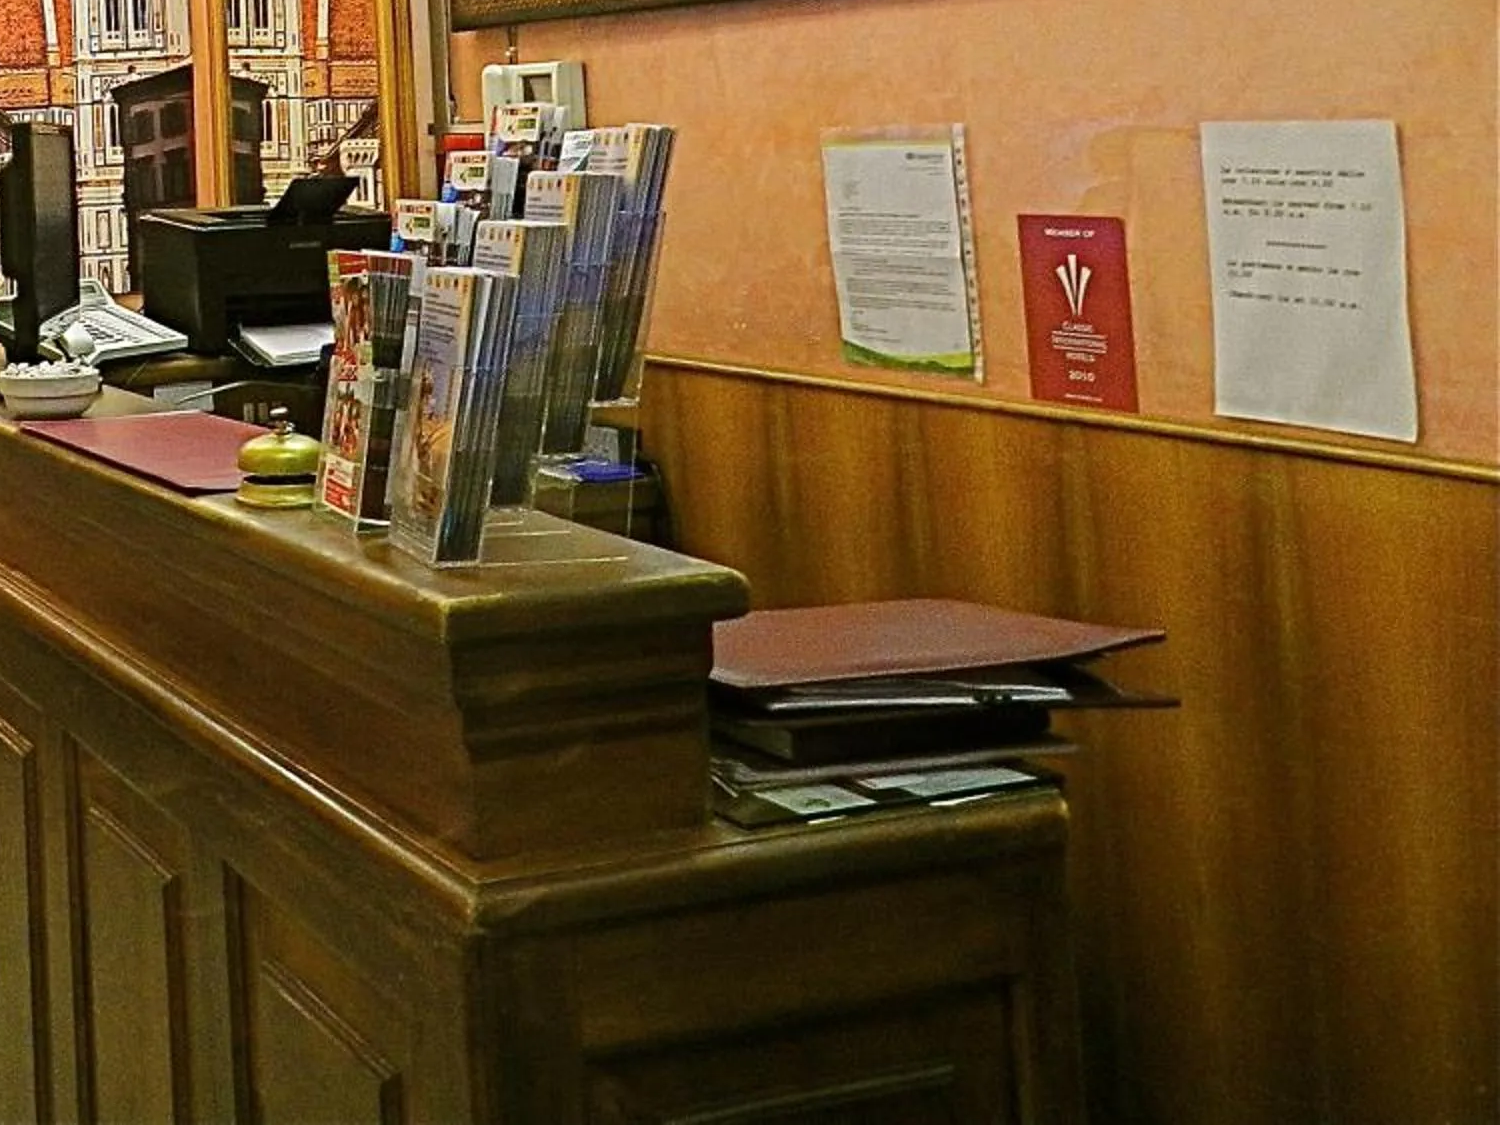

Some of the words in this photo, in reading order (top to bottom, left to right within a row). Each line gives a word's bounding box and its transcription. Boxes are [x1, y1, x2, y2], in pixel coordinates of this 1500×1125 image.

[1044, 228, 1081, 238] MEMBER
[1082, 229, 1095, 238] OF
[1068, 370, 1096, 383] 2010
